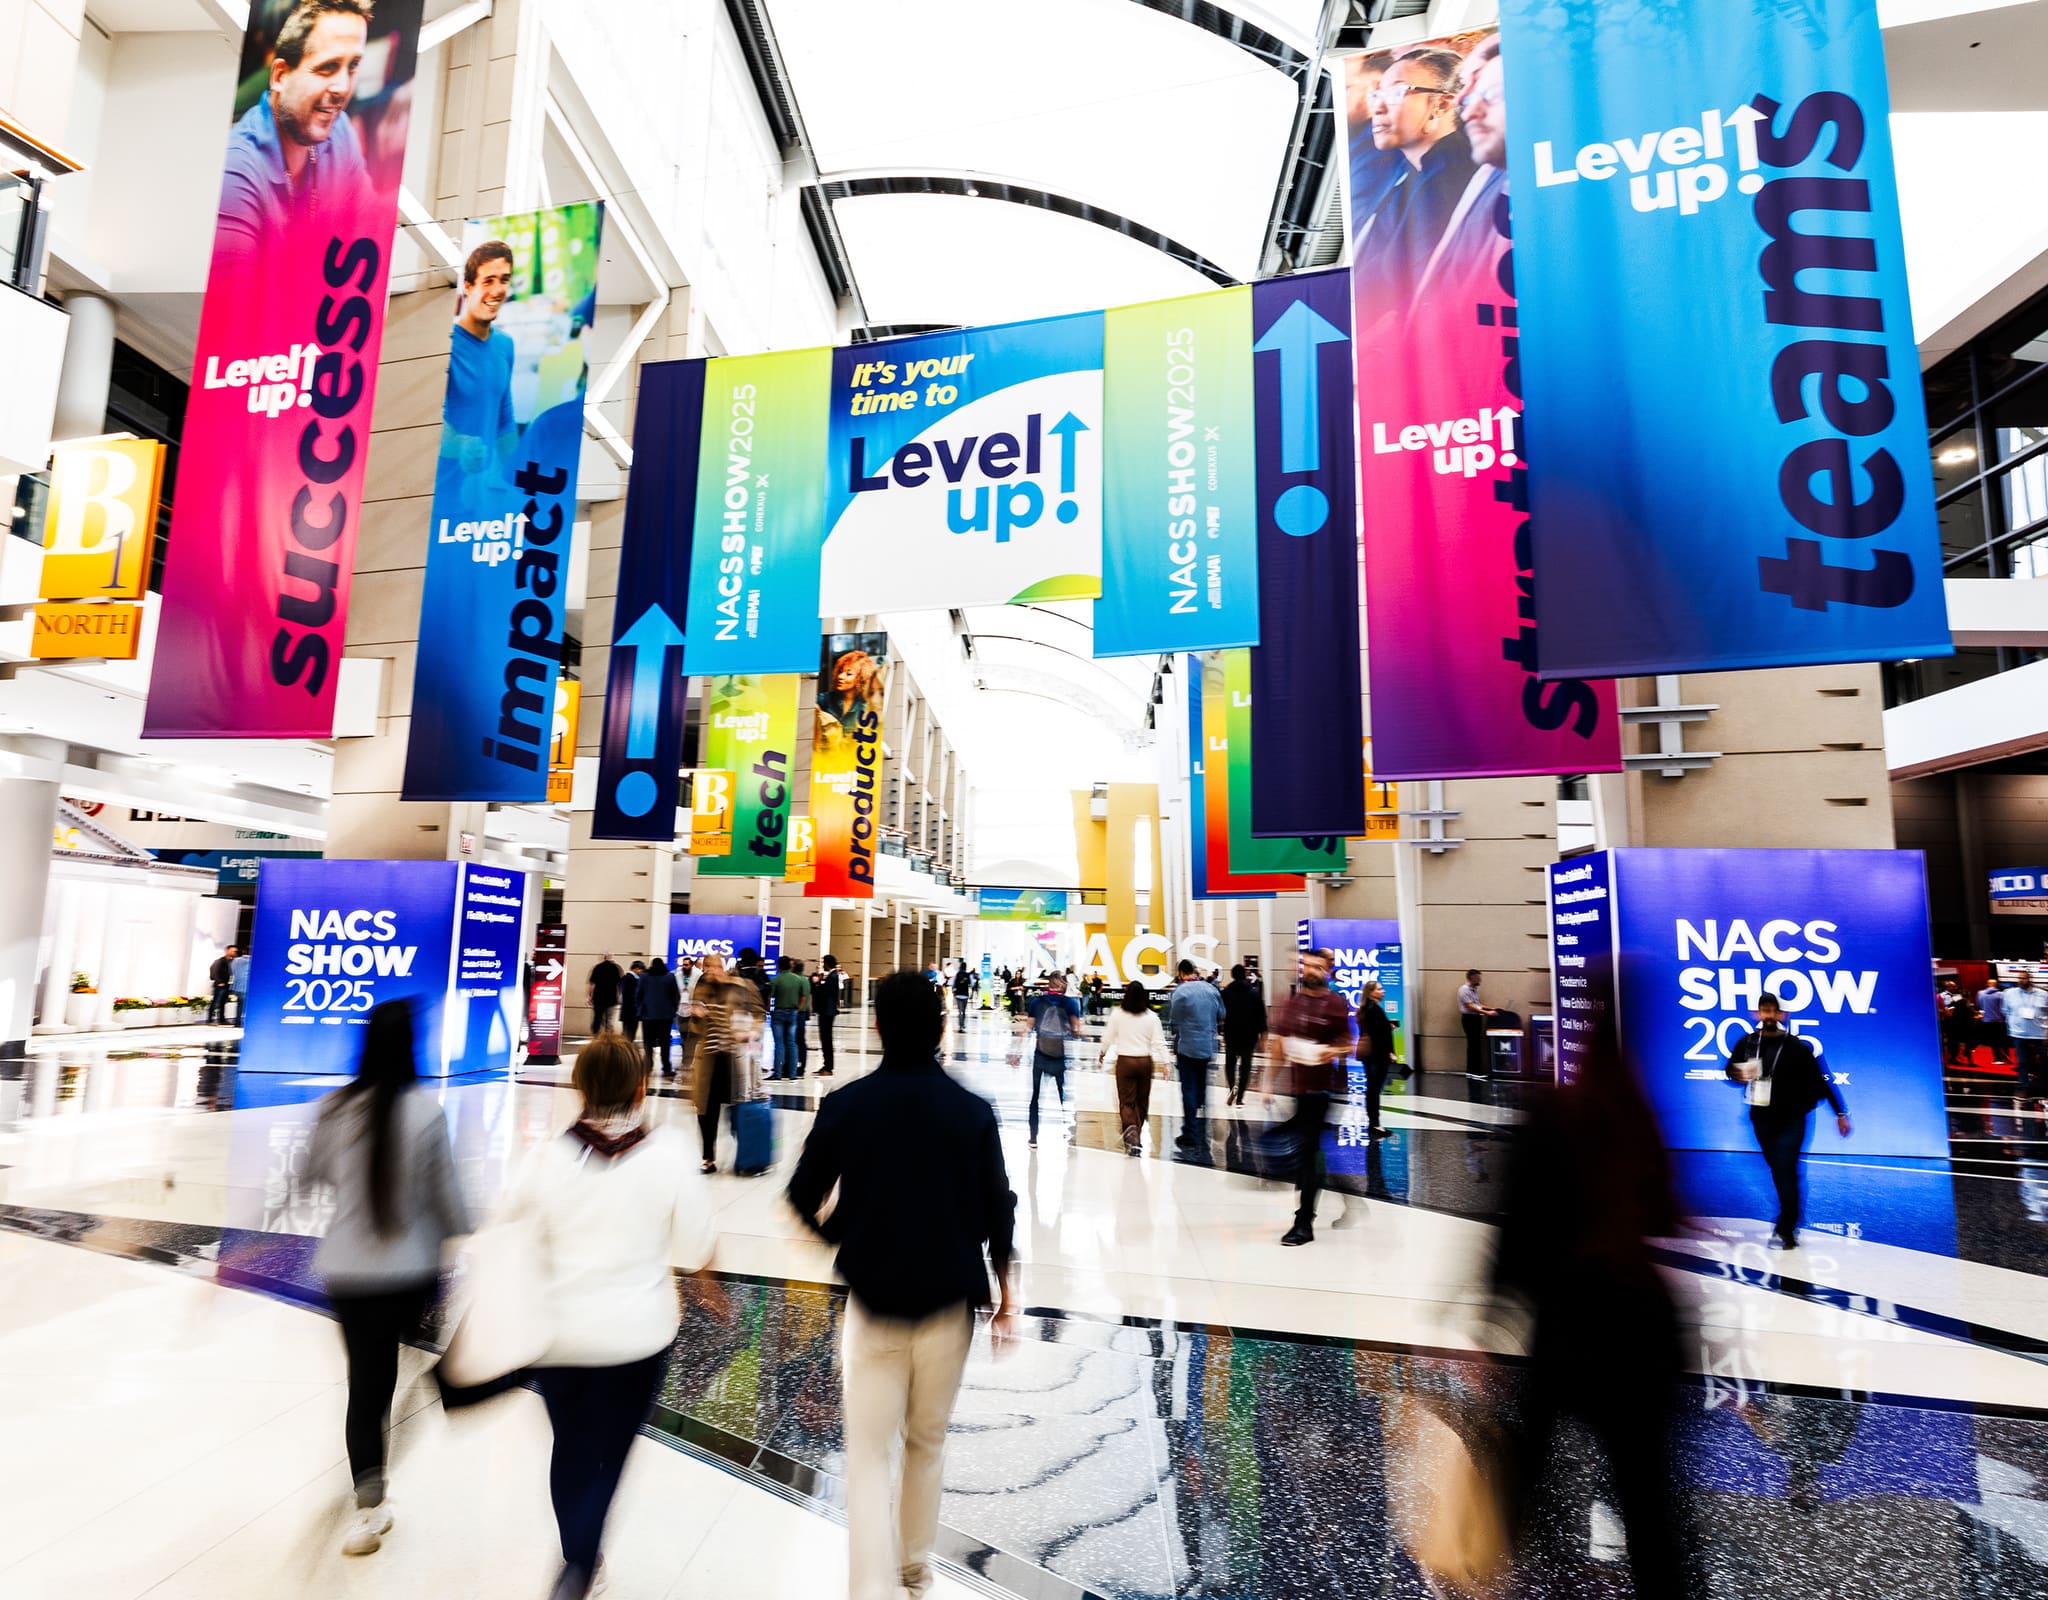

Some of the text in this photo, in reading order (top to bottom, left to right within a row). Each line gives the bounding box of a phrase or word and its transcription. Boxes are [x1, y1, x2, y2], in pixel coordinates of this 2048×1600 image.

[1533, 109, 1724, 187] Level
[204, 344, 302, 389] Level
[902, 354, 975, 386] your
[1756, 91, 1915, 613] teams
[850, 384, 958, 416] time to
[849, 413, 1041, 493] Level
[1373, 408, 1493, 454] Level
[269, 236, 379, 697] success
[438, 512, 514, 543] Level
[35, 614, 129, 635] NORTH
[482, 461, 568, 772] impact
[714, 713, 760, 728] Level
[748, 750, 787, 858] tech
[848, 710, 878, 886] products
[1366, 819, 1398, 830] UTH
[290, 909, 397, 941] NACS
[1675, 919, 1841, 963] NACS
[284, 944, 418, 976] SHOW
[677, 939, 734, 956] NACS
[1334, 948, 1379, 967] NAC
[282, 979, 374, 1011] 2025
[1678, 967, 1880, 1014] SHOW
[1683, 1016, 1823, 1060] 205
